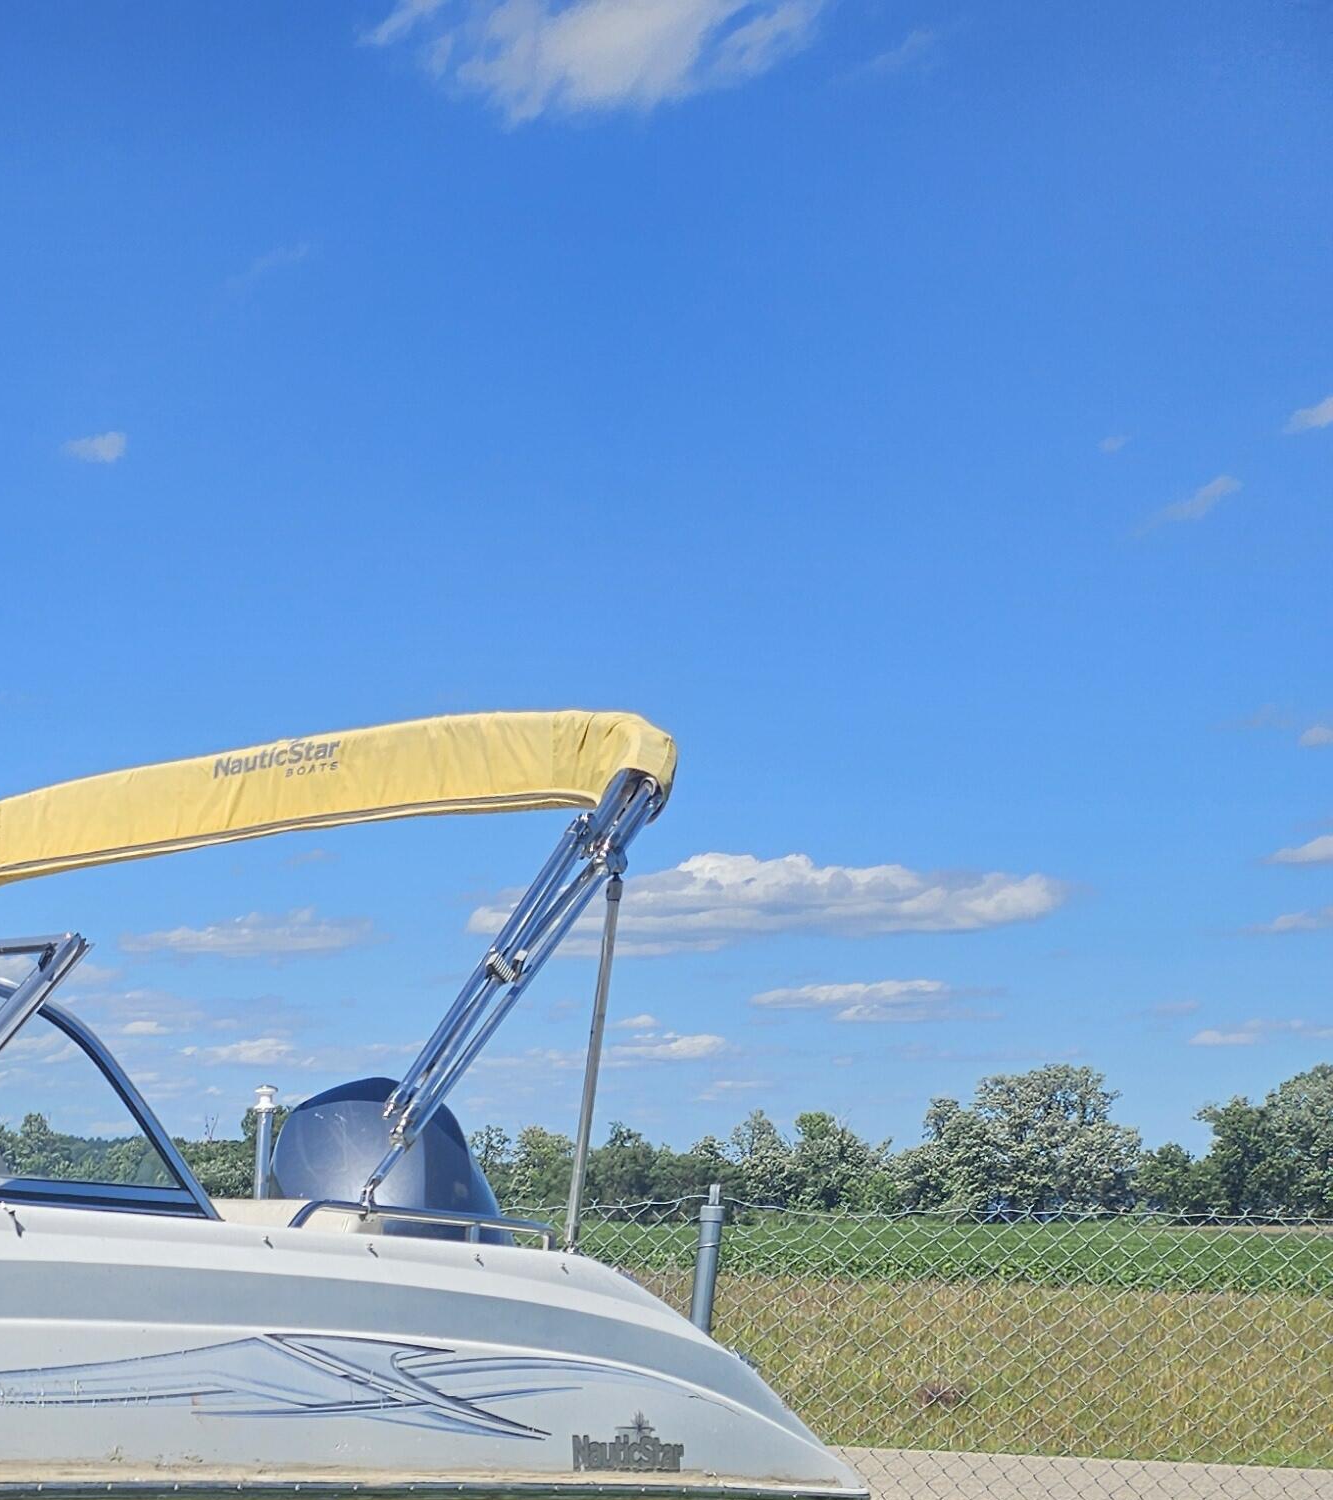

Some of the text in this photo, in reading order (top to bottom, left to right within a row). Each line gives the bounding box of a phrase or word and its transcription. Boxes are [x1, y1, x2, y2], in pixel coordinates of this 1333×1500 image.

[213, 740, 341, 779] NauticStar
[285, 762, 338, 777] BOATS
[572, 1434, 684, 1470] NauticStar
